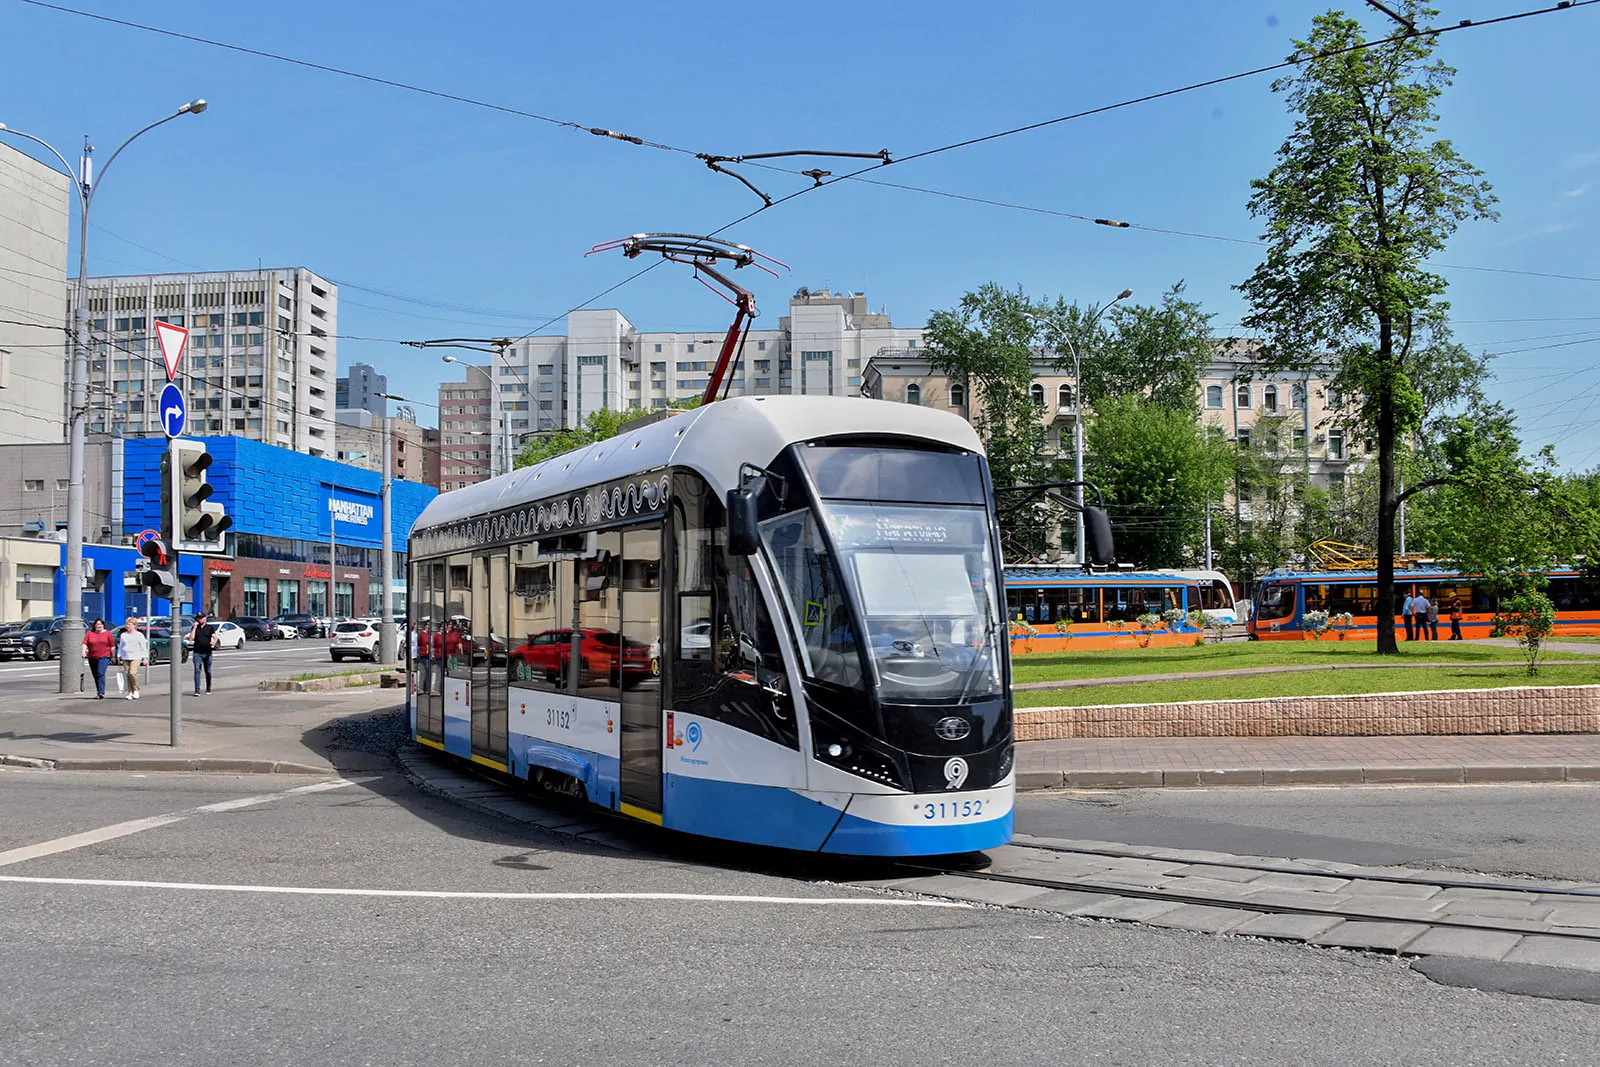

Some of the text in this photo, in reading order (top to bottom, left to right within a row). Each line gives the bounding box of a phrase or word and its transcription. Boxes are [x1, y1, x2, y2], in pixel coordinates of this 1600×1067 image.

[328, 498, 373, 519] MANHATTAN
[546, 708, 570, 730] 31152
[924, 800, 983, 819] 31152
